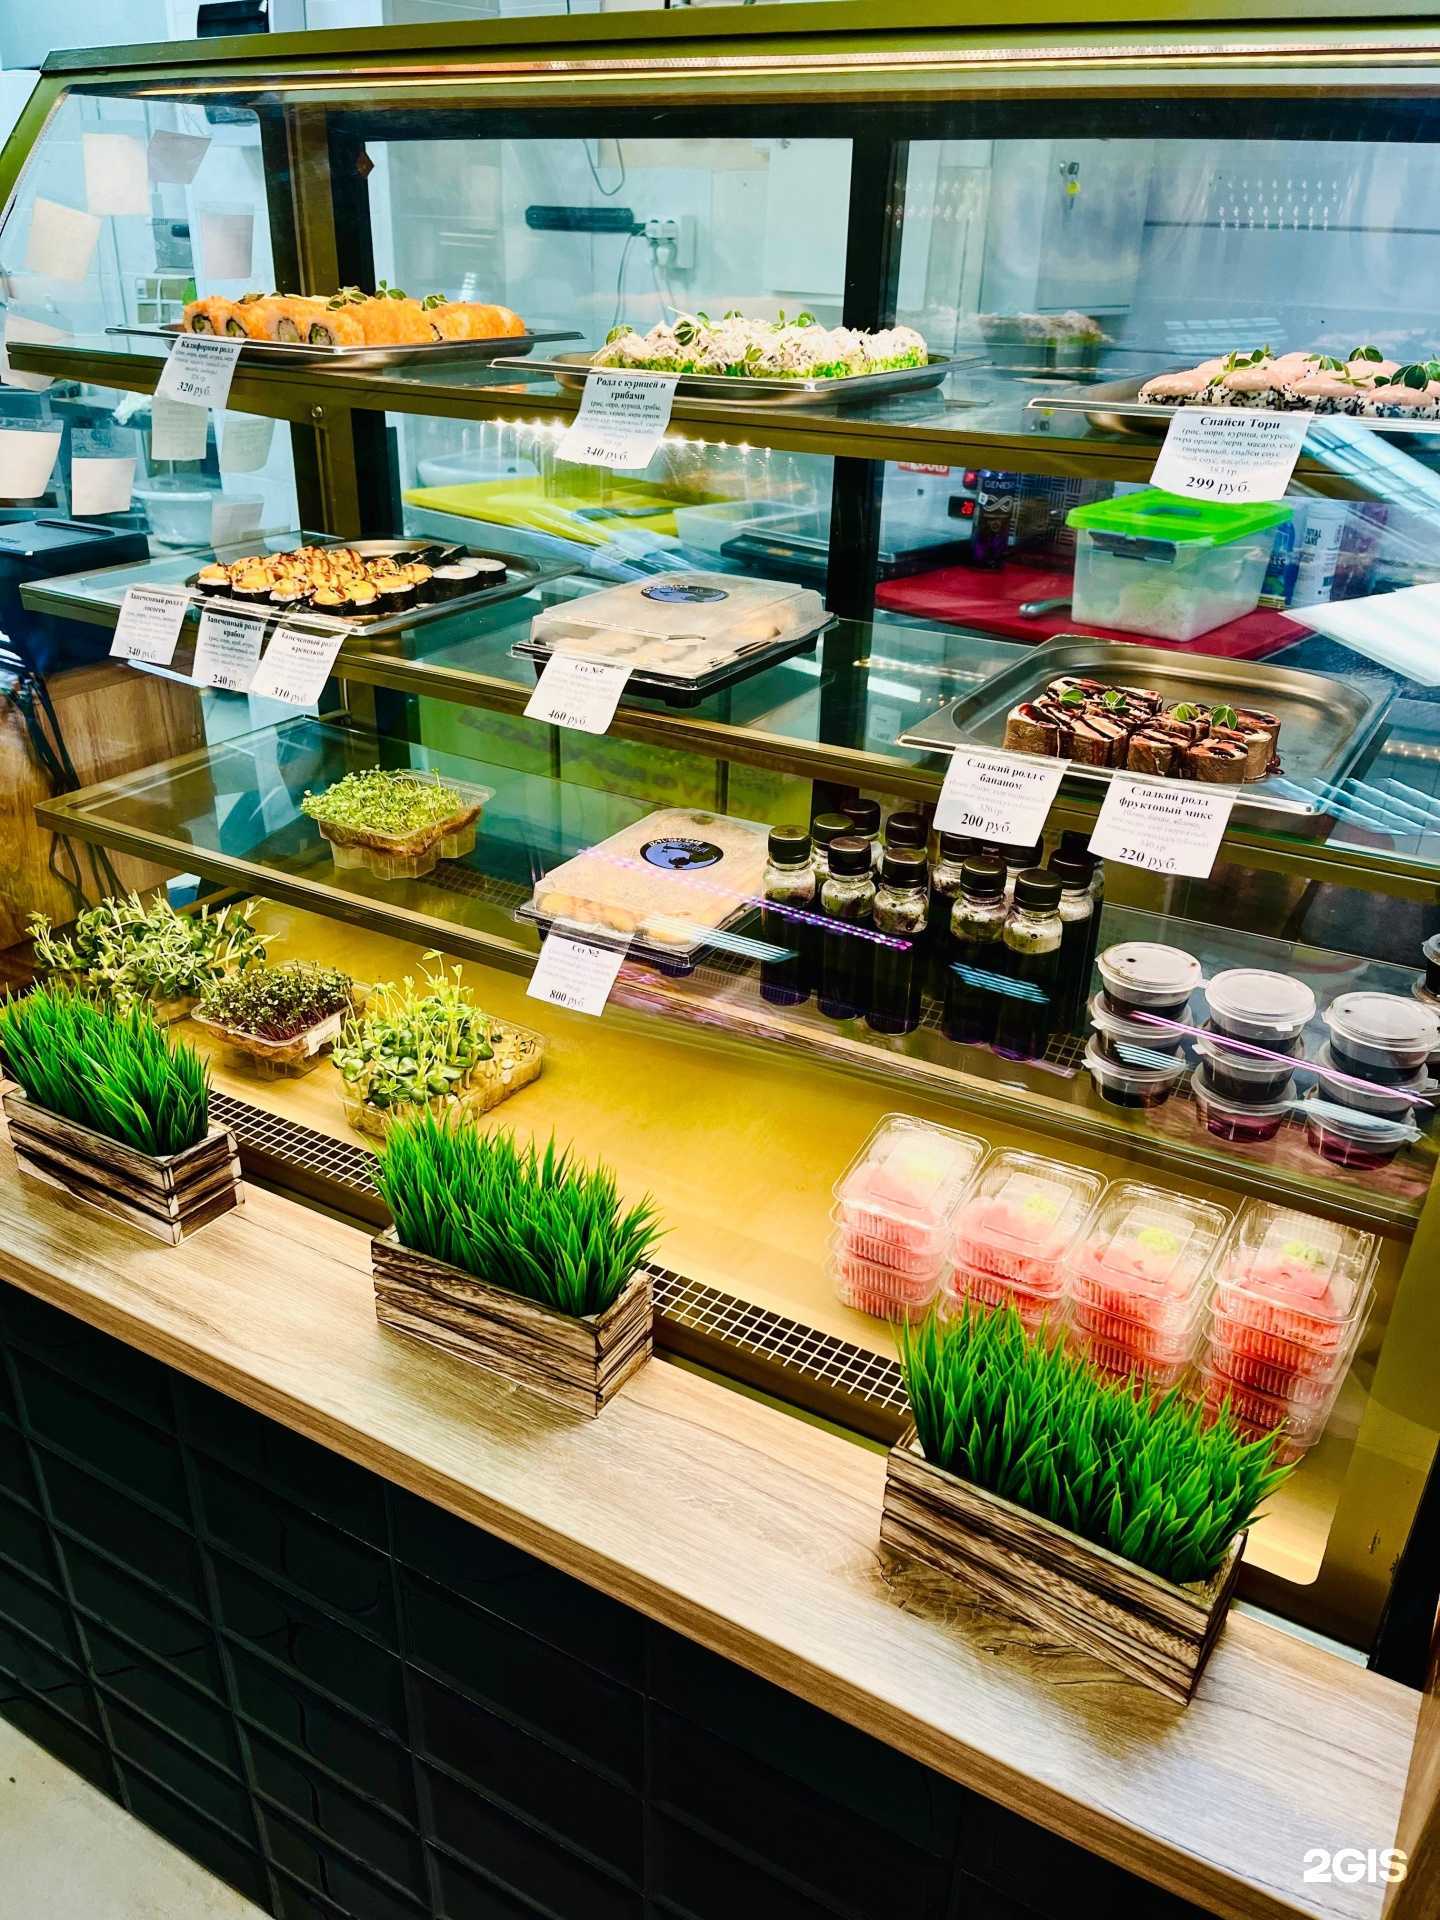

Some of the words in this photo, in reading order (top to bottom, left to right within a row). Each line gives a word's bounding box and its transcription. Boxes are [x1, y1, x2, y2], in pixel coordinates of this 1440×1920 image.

[177, 382, 193, 393] 320
[596, 377, 616, 386] Ролл
[624, 380, 658, 390] курицей
[611, 391, 645, 401] грибами
[1200, 416, 1245, 428] Спайси
[1249, 418, 1281, 430] Тори
[584, 447, 604, 457] 340
[1185, 476, 1215, 490] 299
[1217, 481, 1251, 495] руб.
[223, 630, 246, 639] крабом
[212, 673, 228, 685] 240
[272, 686, 290, 698] 310
[548, 709, 567, 721] 460
[967, 758, 1011, 775] Сладкий
[1011, 768, 1038, 781] ролл
[1039, 774, 1046, 782] с
[979, 773, 1024, 791] бананом
[1131, 786, 1179, 802] Сладкий
[1180, 795, 1209, 807] ролл
[1119, 797, 1182, 816] фруктовый
[1185, 810, 1214, 820] микс
[960, 812, 984, 828] 200
[985, 820, 1012, 835] руб.
[1119, 847, 1145, 862] 220
[1147, 856, 1177, 871] руб.
[549, 989, 567, 1002] 800
